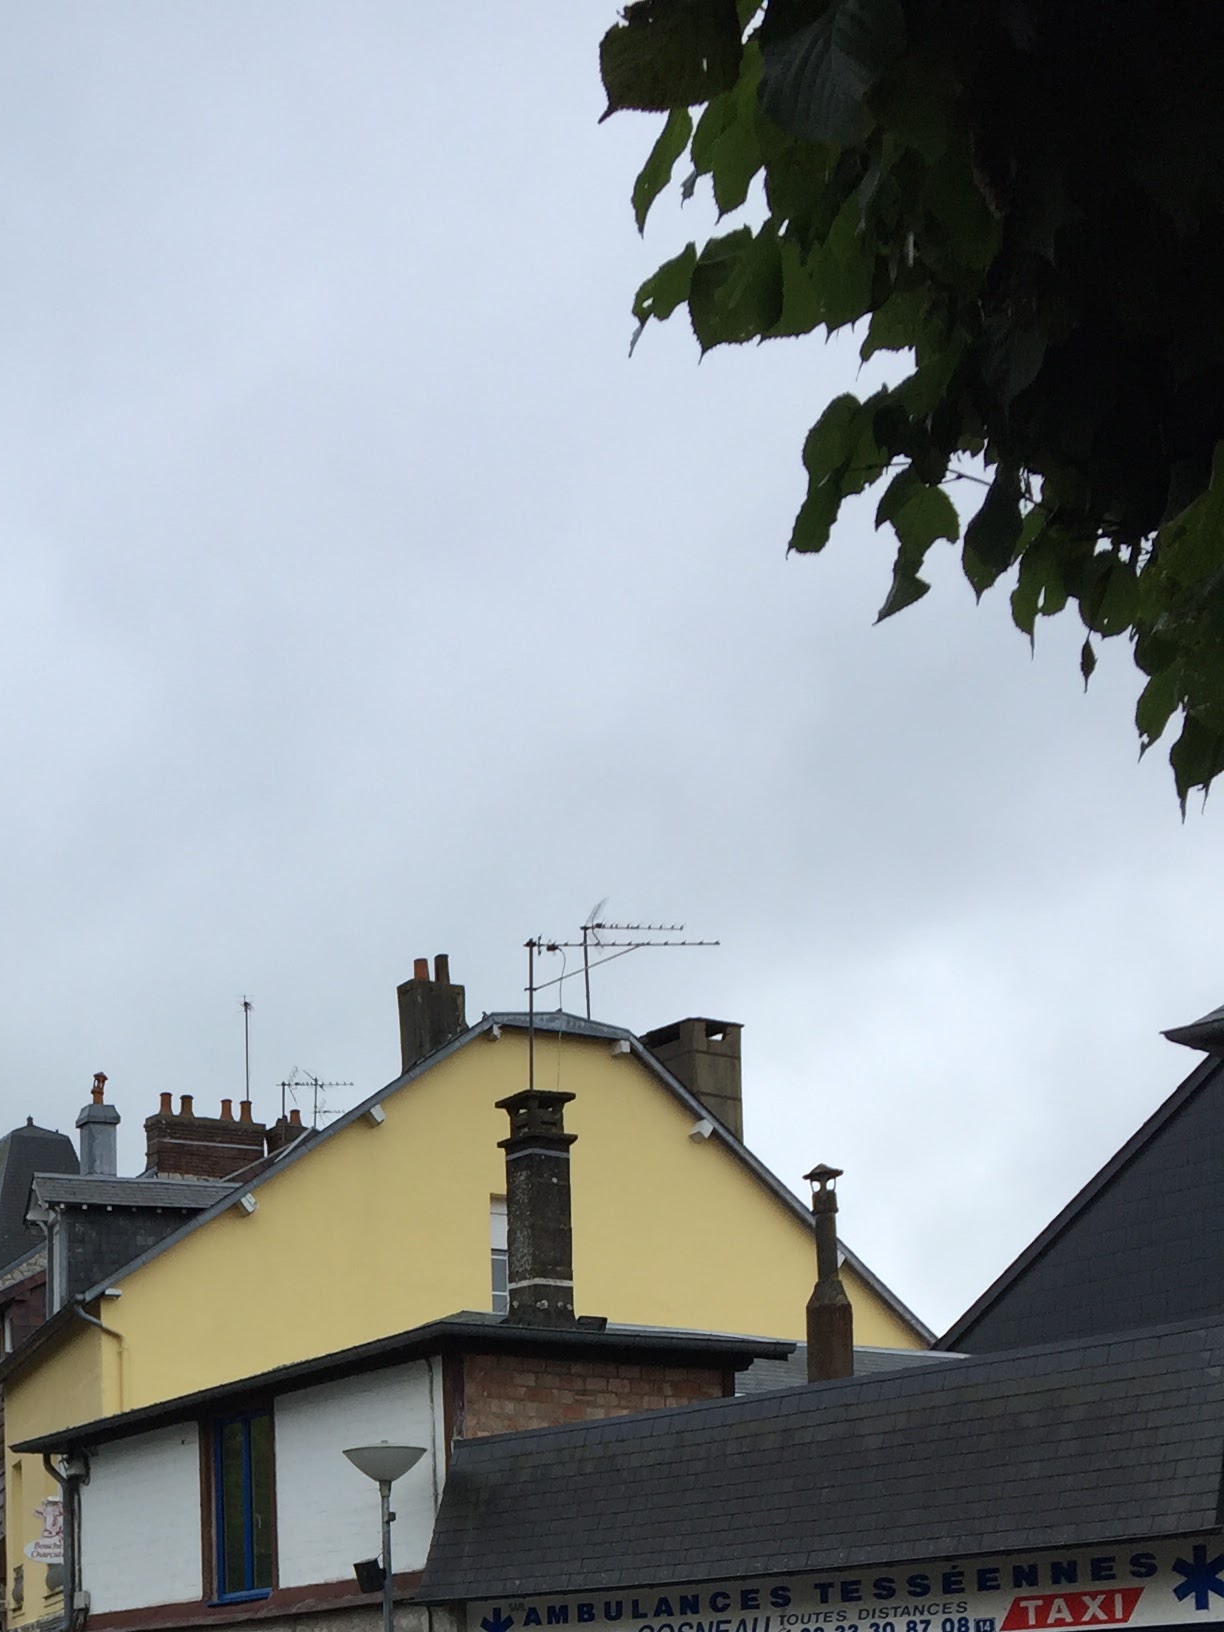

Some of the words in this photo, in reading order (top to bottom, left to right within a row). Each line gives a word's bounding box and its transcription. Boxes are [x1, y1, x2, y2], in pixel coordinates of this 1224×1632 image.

[523, 1586, 792, 1626] AMBULANCES
[814, 1552, 1158, 1604] TESSÉENNES
[779, 1609, 848, 1627] TOUTES
[858, 1601, 968, 1621] DISTANCES
[1019, 1593, 1124, 1625] TAXI
